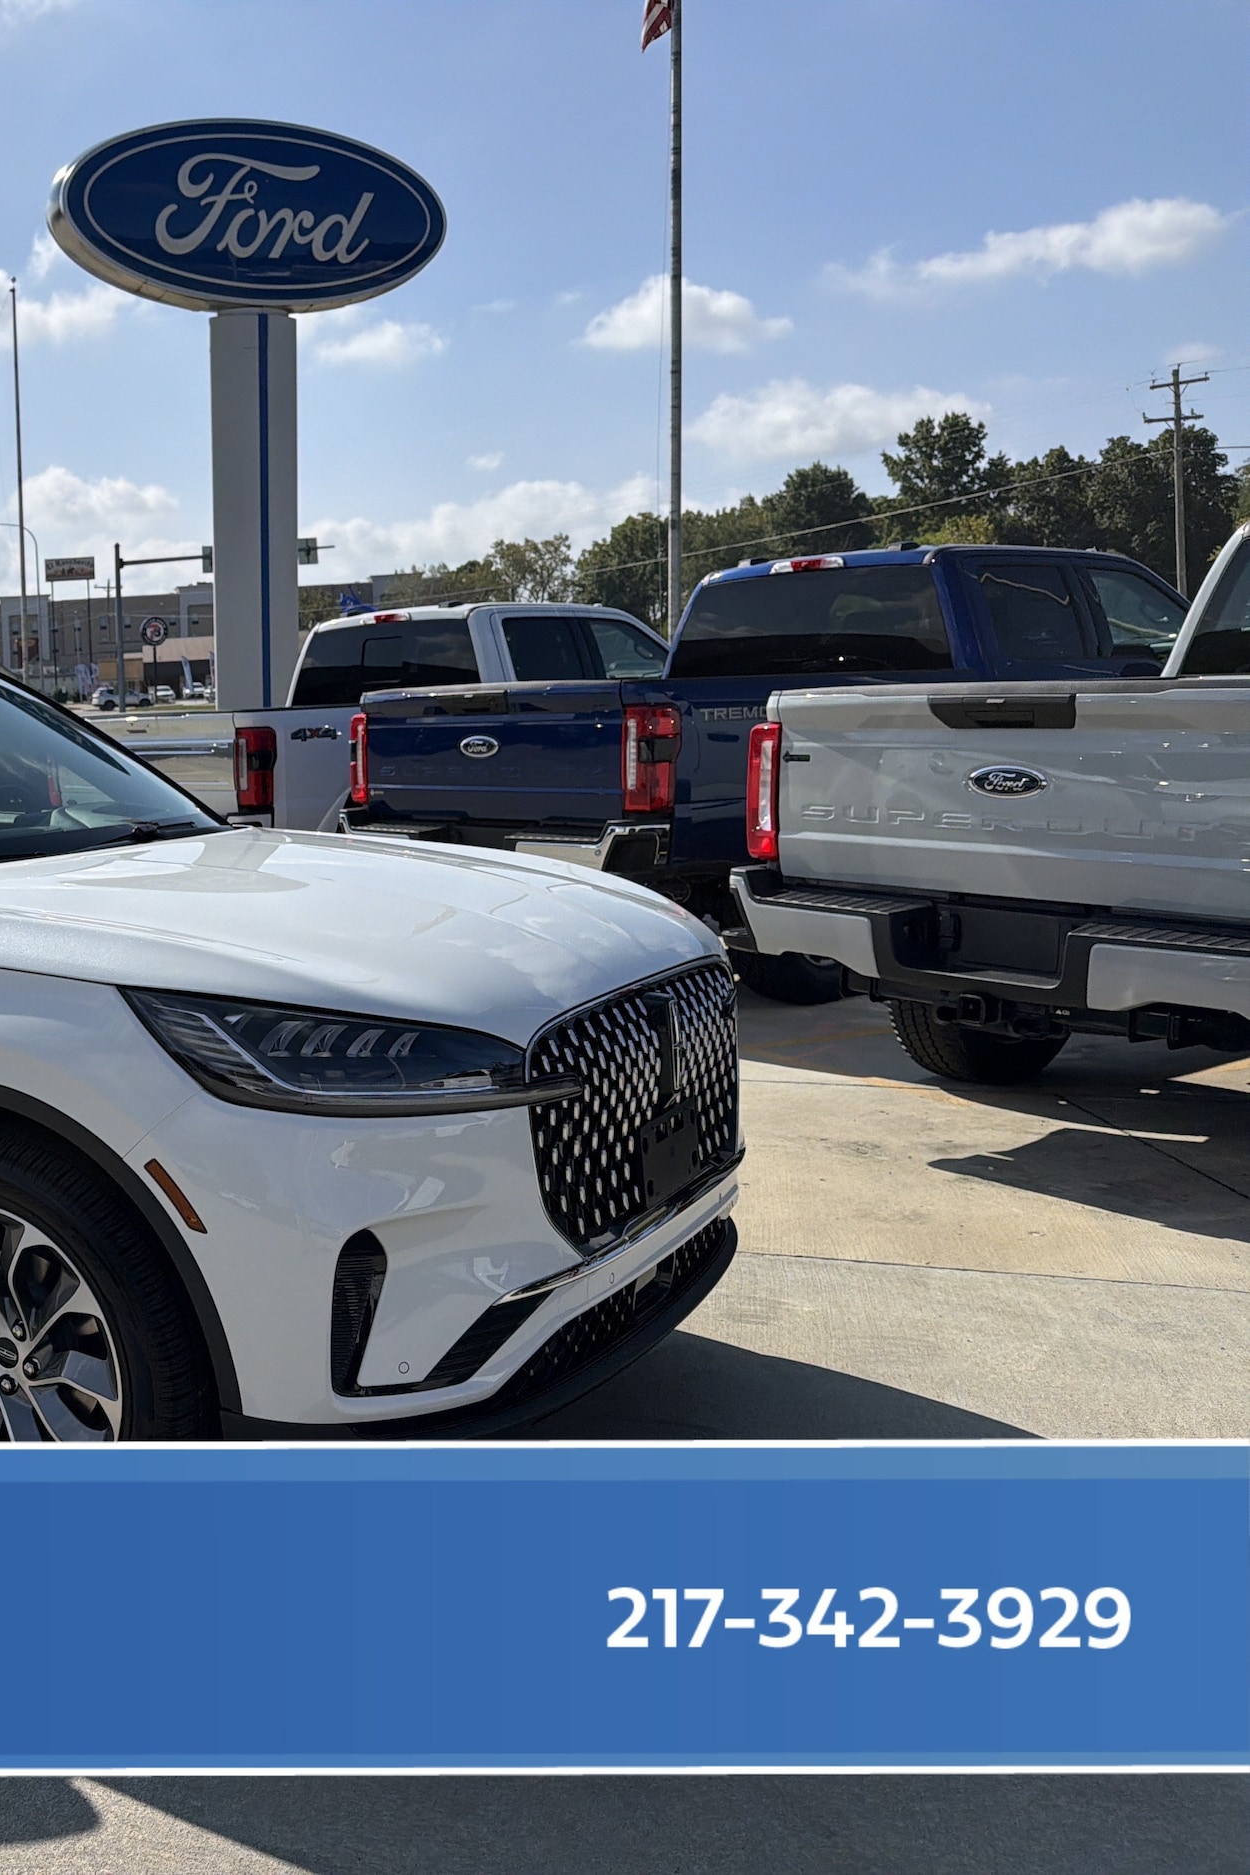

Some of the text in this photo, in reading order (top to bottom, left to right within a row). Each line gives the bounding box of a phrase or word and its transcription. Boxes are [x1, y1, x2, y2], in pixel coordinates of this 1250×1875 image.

[155, 152, 374, 264] Ford
[468, 740, 489, 752] Ford
[984, 771, 1029, 791] Ford
[801, 804, 1023, 832] SUPER
